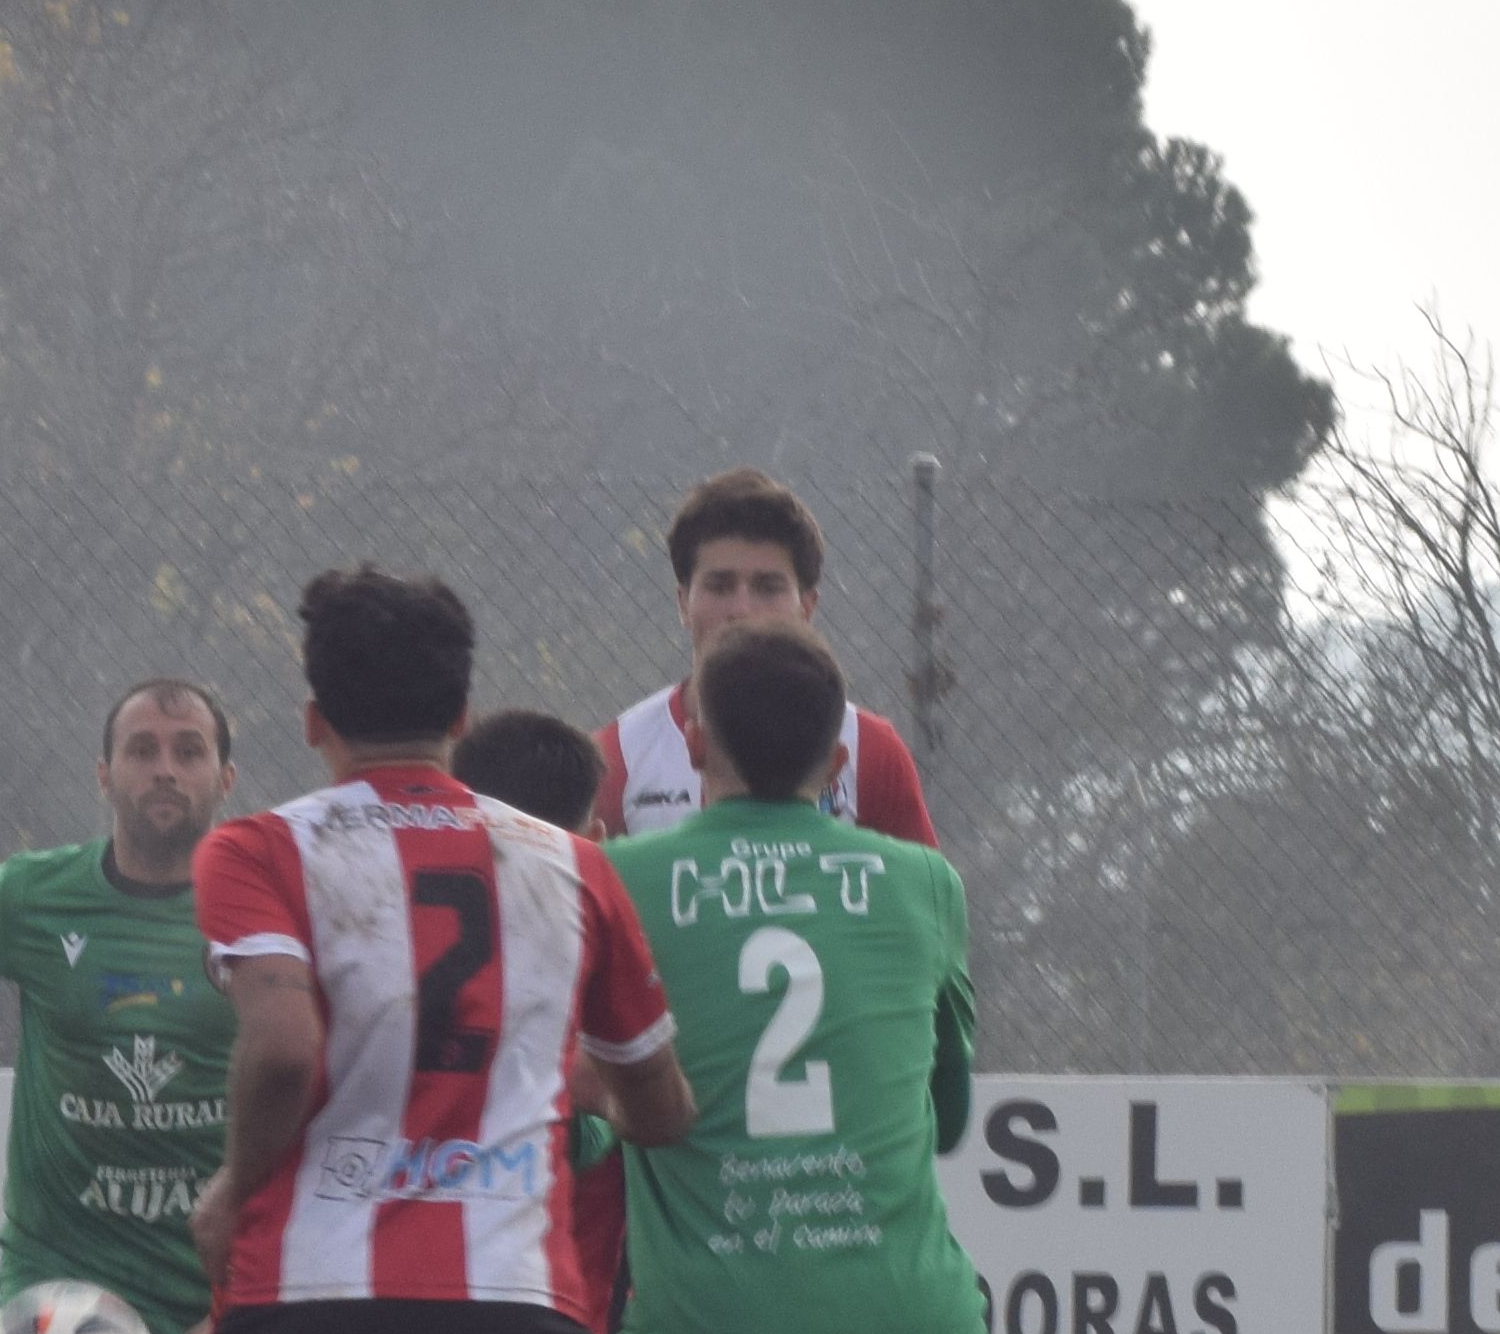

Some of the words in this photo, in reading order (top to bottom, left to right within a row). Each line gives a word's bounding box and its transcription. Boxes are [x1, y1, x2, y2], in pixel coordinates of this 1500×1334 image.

[731, 837, 812, 862] Grupo
[410, 871, 498, 1072] 2
[737, 925, 835, 1140] 2
[60, 1092, 127, 1130] CAJA
[980, 1098, 1245, 1211] S.L.
